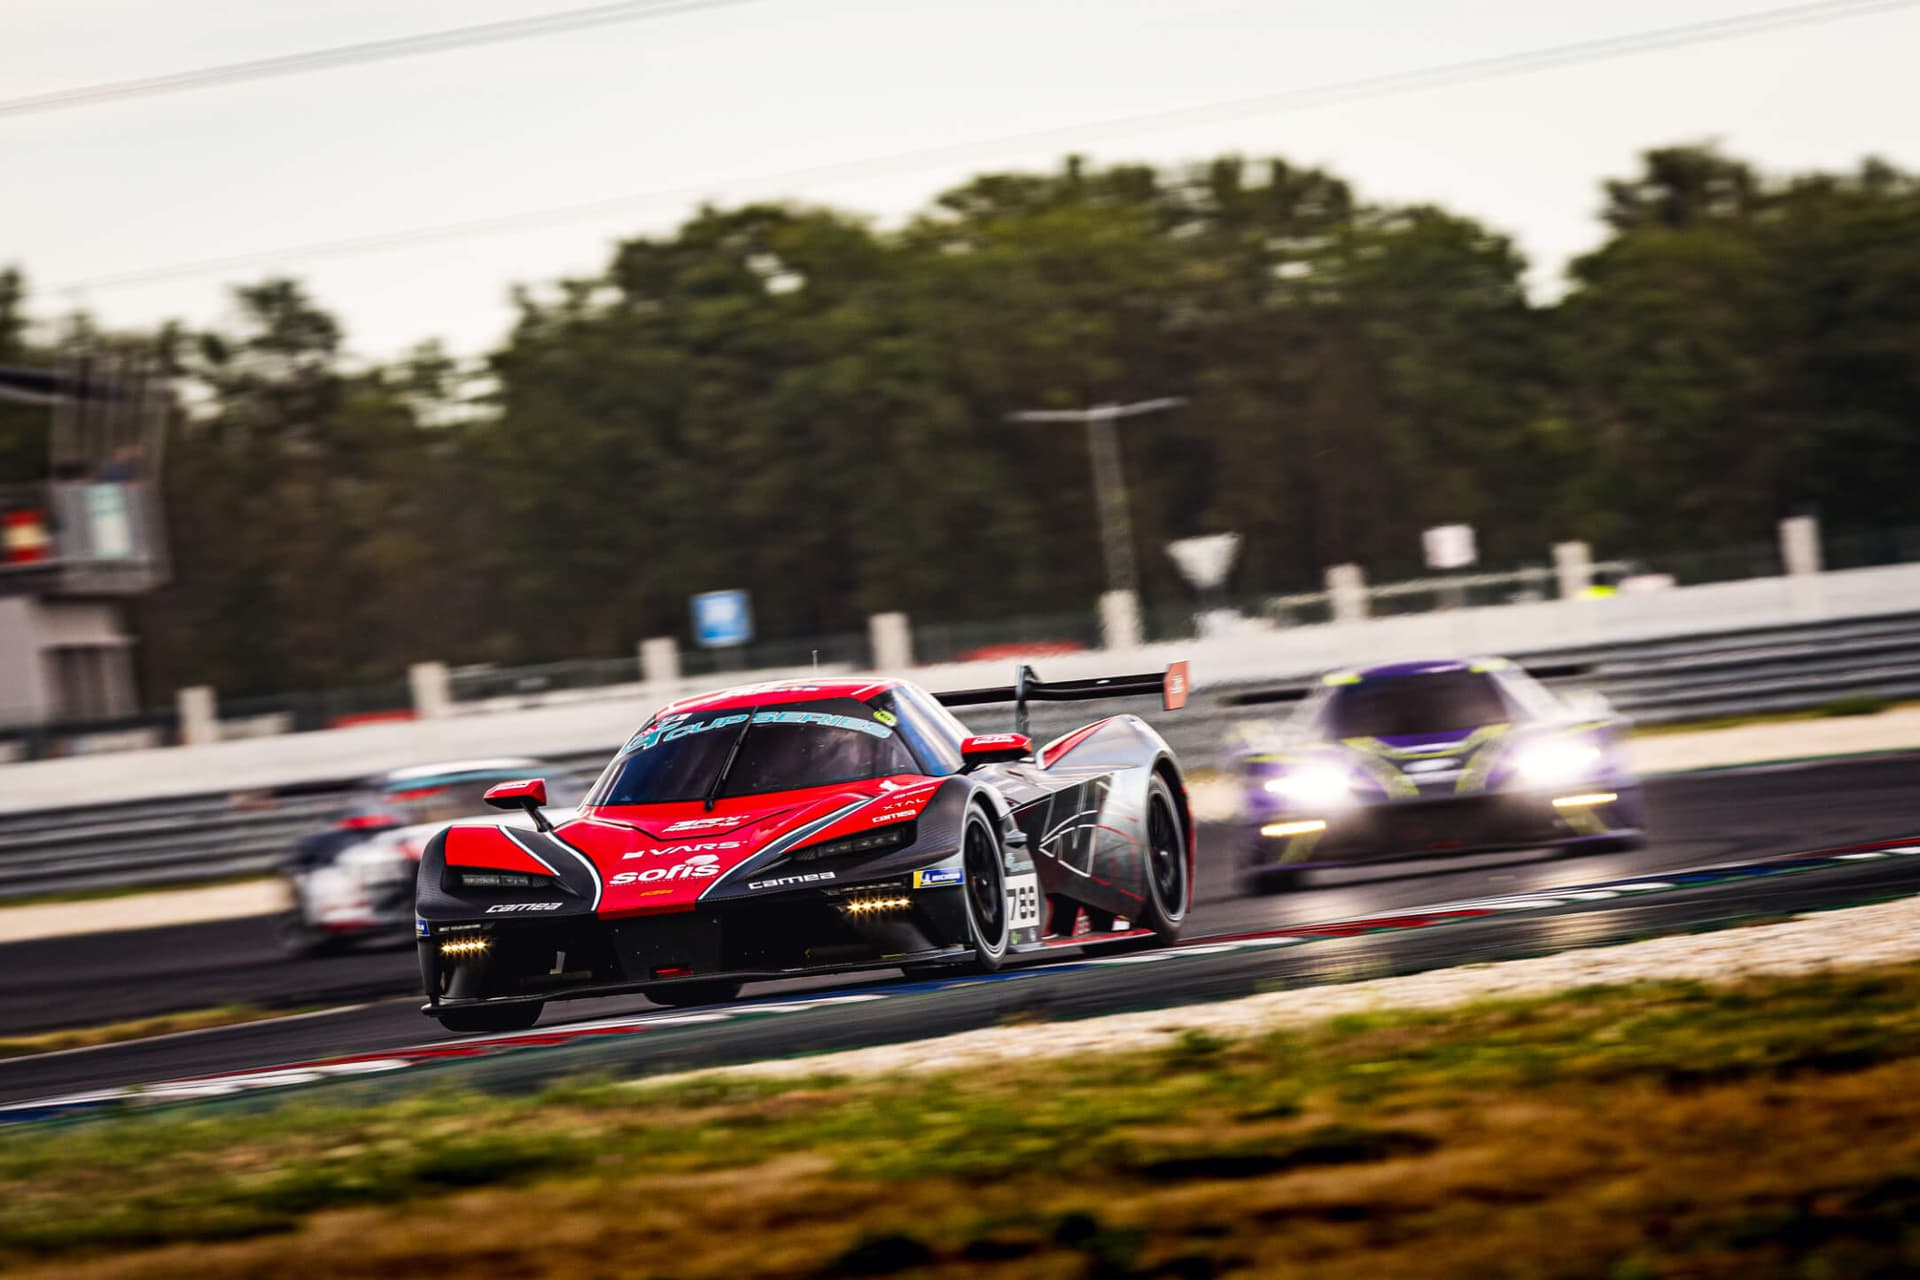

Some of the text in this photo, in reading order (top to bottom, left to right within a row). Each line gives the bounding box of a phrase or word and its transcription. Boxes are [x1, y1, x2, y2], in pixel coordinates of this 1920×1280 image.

[649, 841, 741, 856] VARS
[609, 863, 721, 885] sofis
[748, 871, 837, 890] camea
[485, 902, 564, 914] camea
